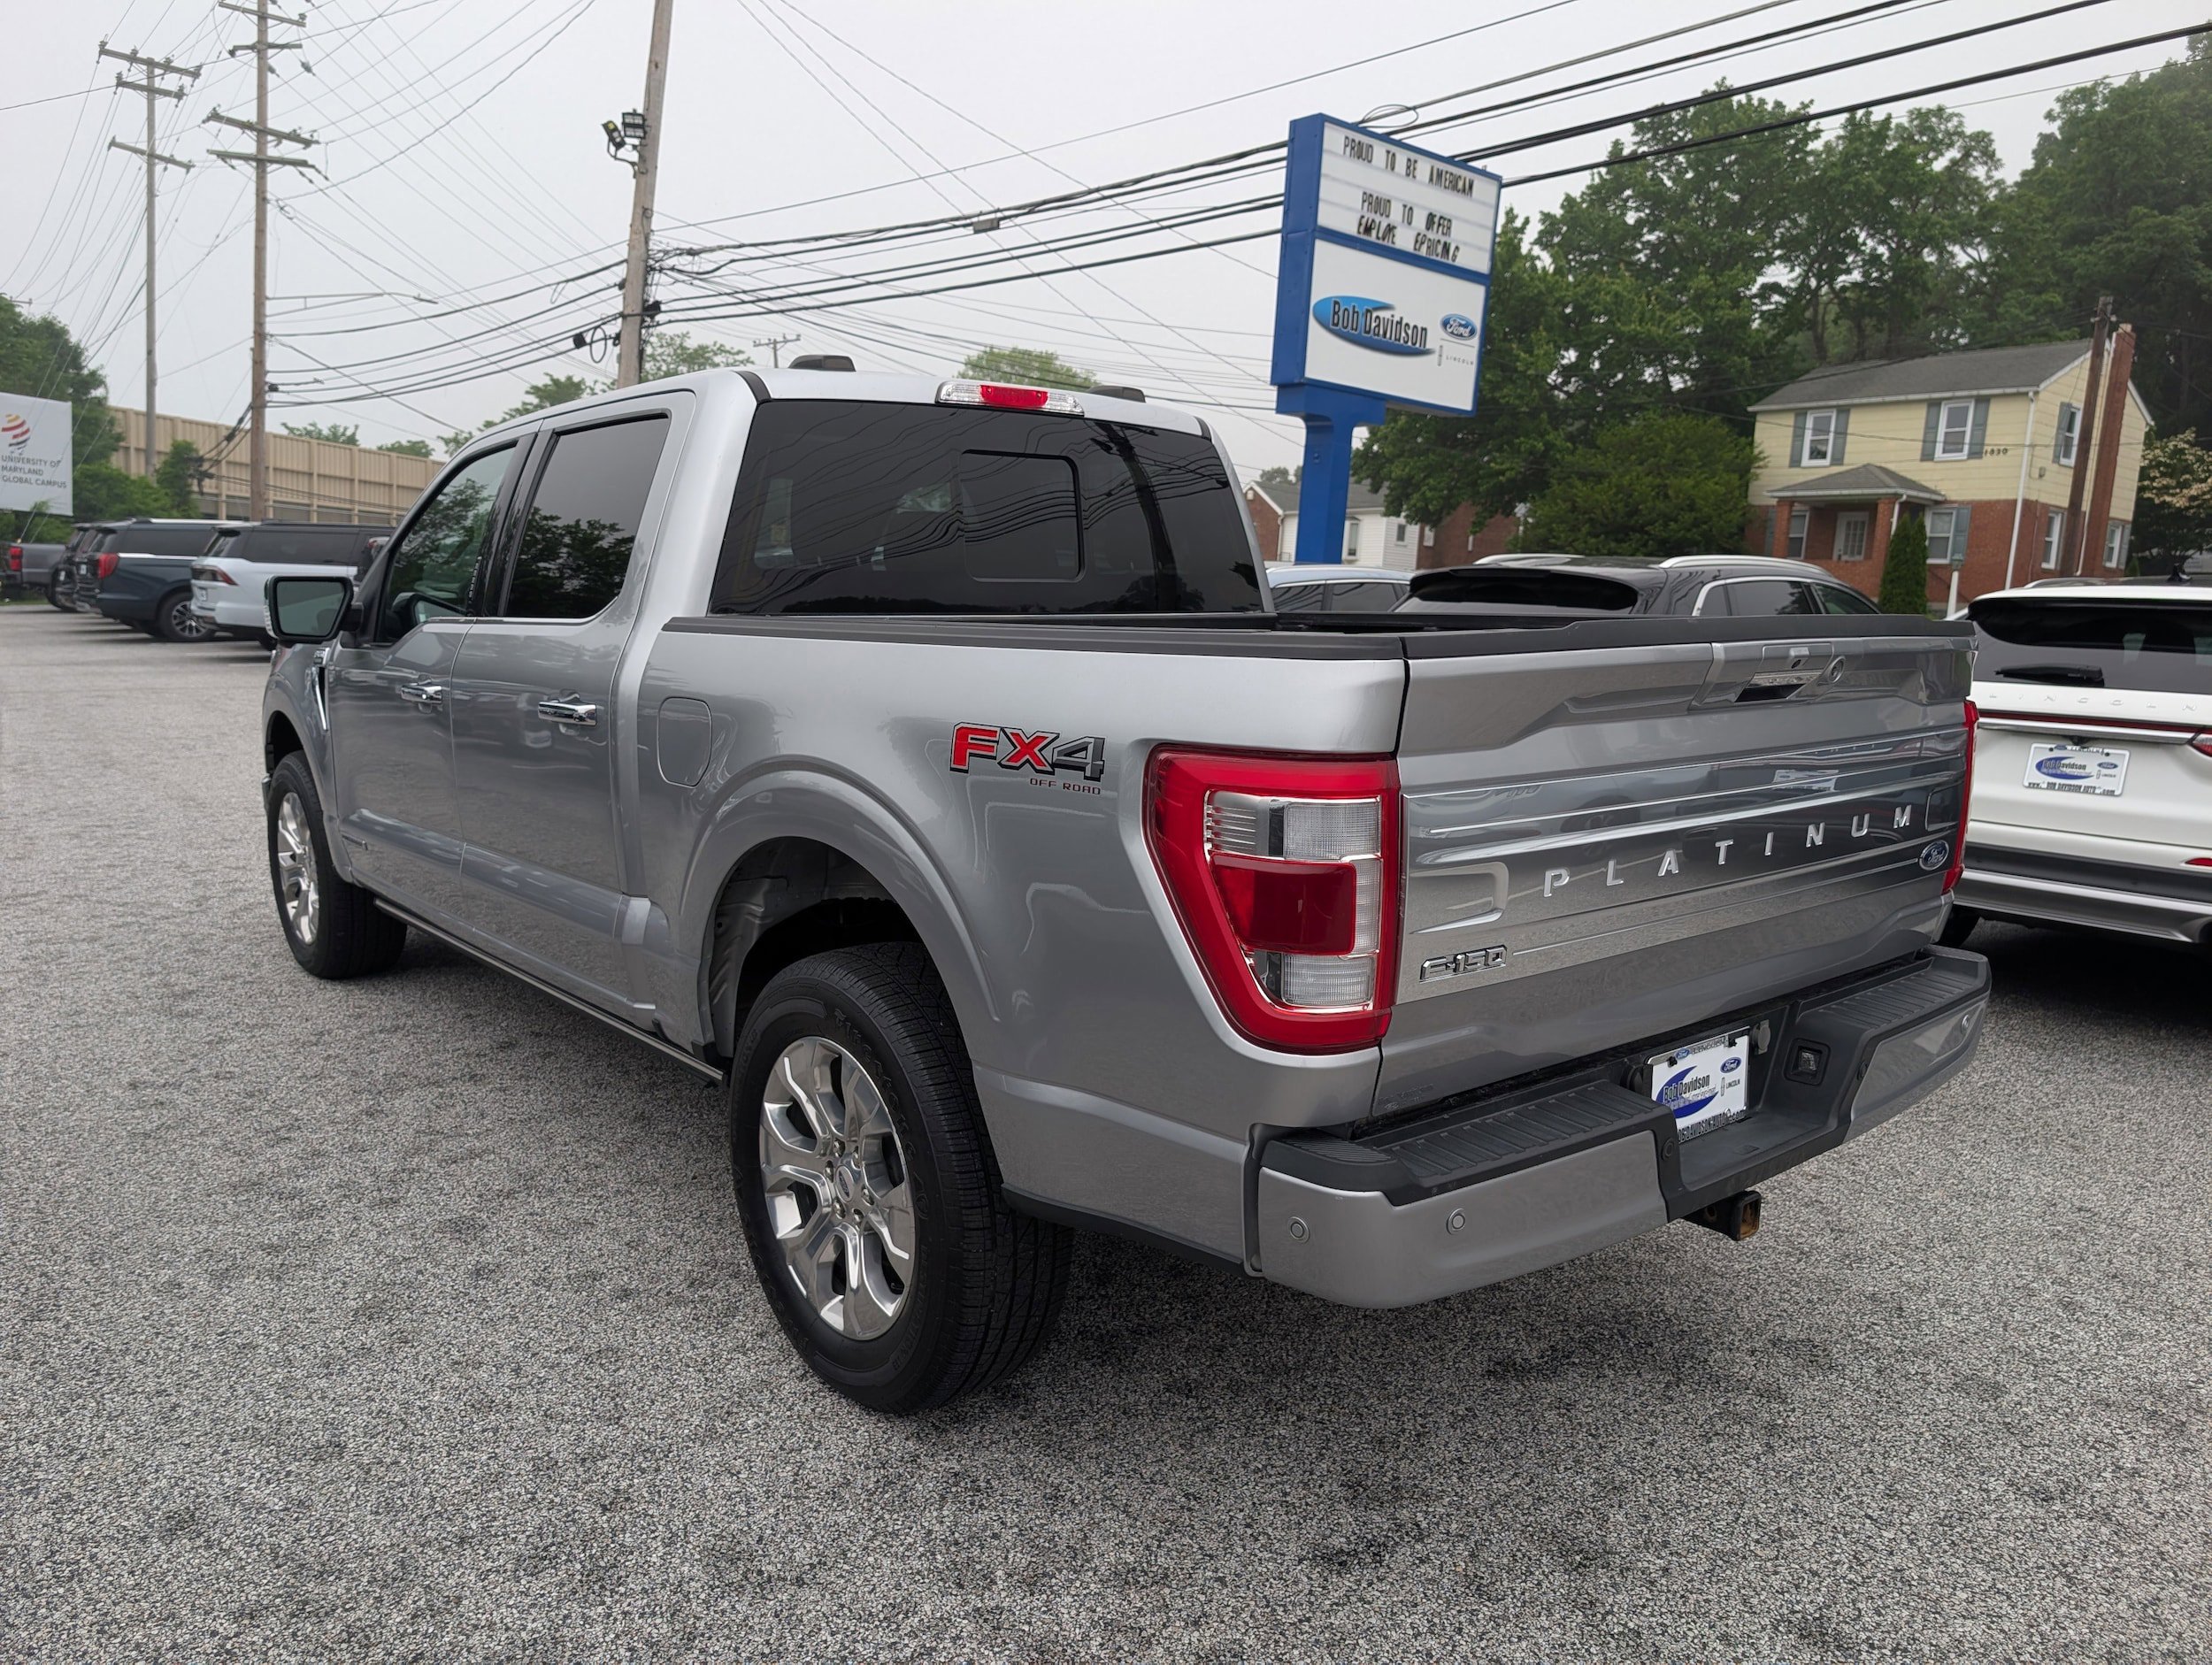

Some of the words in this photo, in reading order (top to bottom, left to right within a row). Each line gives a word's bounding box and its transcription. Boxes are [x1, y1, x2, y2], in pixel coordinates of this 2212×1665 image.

[1343, 135, 1374, 164] PROUD
[1385, 150, 1396, 172] TO
[1405, 158, 1417, 179] BE
[1428, 165, 1474, 198] AMERICAN
[1361, 191, 1392, 219] PROUD
[1402, 203, 1414, 226] TO
[1425, 211, 1452, 238] OFFER
[1331, 300, 1360, 333] Bob
[1363, 308, 1428, 349] Davidson
[1, 454, 48, 467] UNIVERSITY
[50, 459, 62, 468] OF
[1, 464, 44, 476] MARYLAND
[2, 475, 34, 486] GLOBAL
[35, 478, 67, 488] CAMPUS
[949, 721, 1106, 782] FX4
[2057, 760, 2086, 771] Davidson
[1029, 777, 1057, 789] OFF
[1063, 782, 1102, 795] ROAD
[1542, 803, 1912, 897] PLATINUM
[1419, 944, 1507, 984] F-150
[1663, 1082, 1678, 1101] Bob
[1678, 1074, 1710, 1096] Davidson
